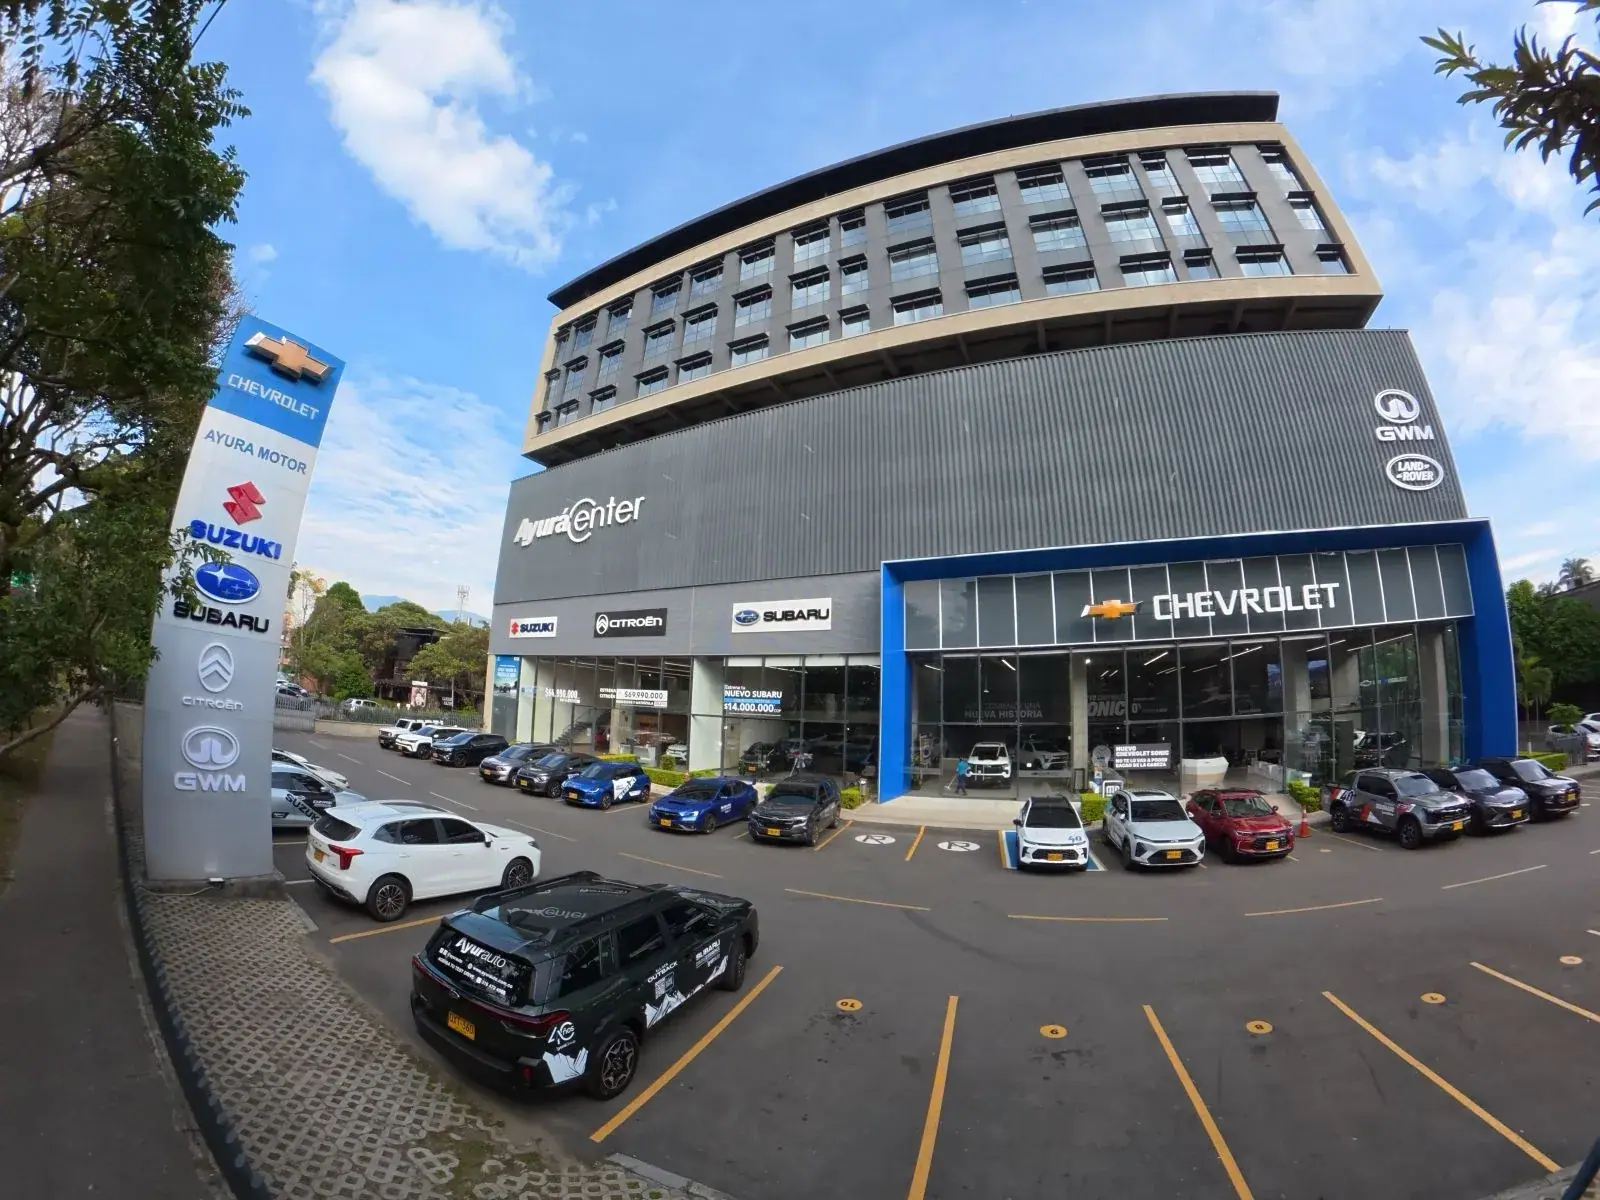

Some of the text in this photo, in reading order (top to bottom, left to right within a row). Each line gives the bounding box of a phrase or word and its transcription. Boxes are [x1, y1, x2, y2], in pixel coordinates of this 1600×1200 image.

[227, 373, 319, 421] CHEVROLET
[1375, 425, 1435, 441] GWM
[204, 429, 307, 475] AYURA MOTOR
[1397, 461, 1422, 471] LAND
[1402, 470, 1434, 481] ROVER
[190, 519, 282, 560] SUZUKI
[1152, 582, 1340, 621] CHEVROLET
[173, 600, 270, 633] SUBARU
[609, 616, 663, 628] CITROËN
[763, 608, 830, 622] SUBARU
[520, 622, 555, 633] SUZUKI
[724, 702, 774, 713] $14.000.000
[1087, 700, 1125, 717] ONIC
[285, 794, 320, 822] SUZUK
[455, 937, 506, 968] Ayurauto
[647, 960, 679, 983] OUTBACK
